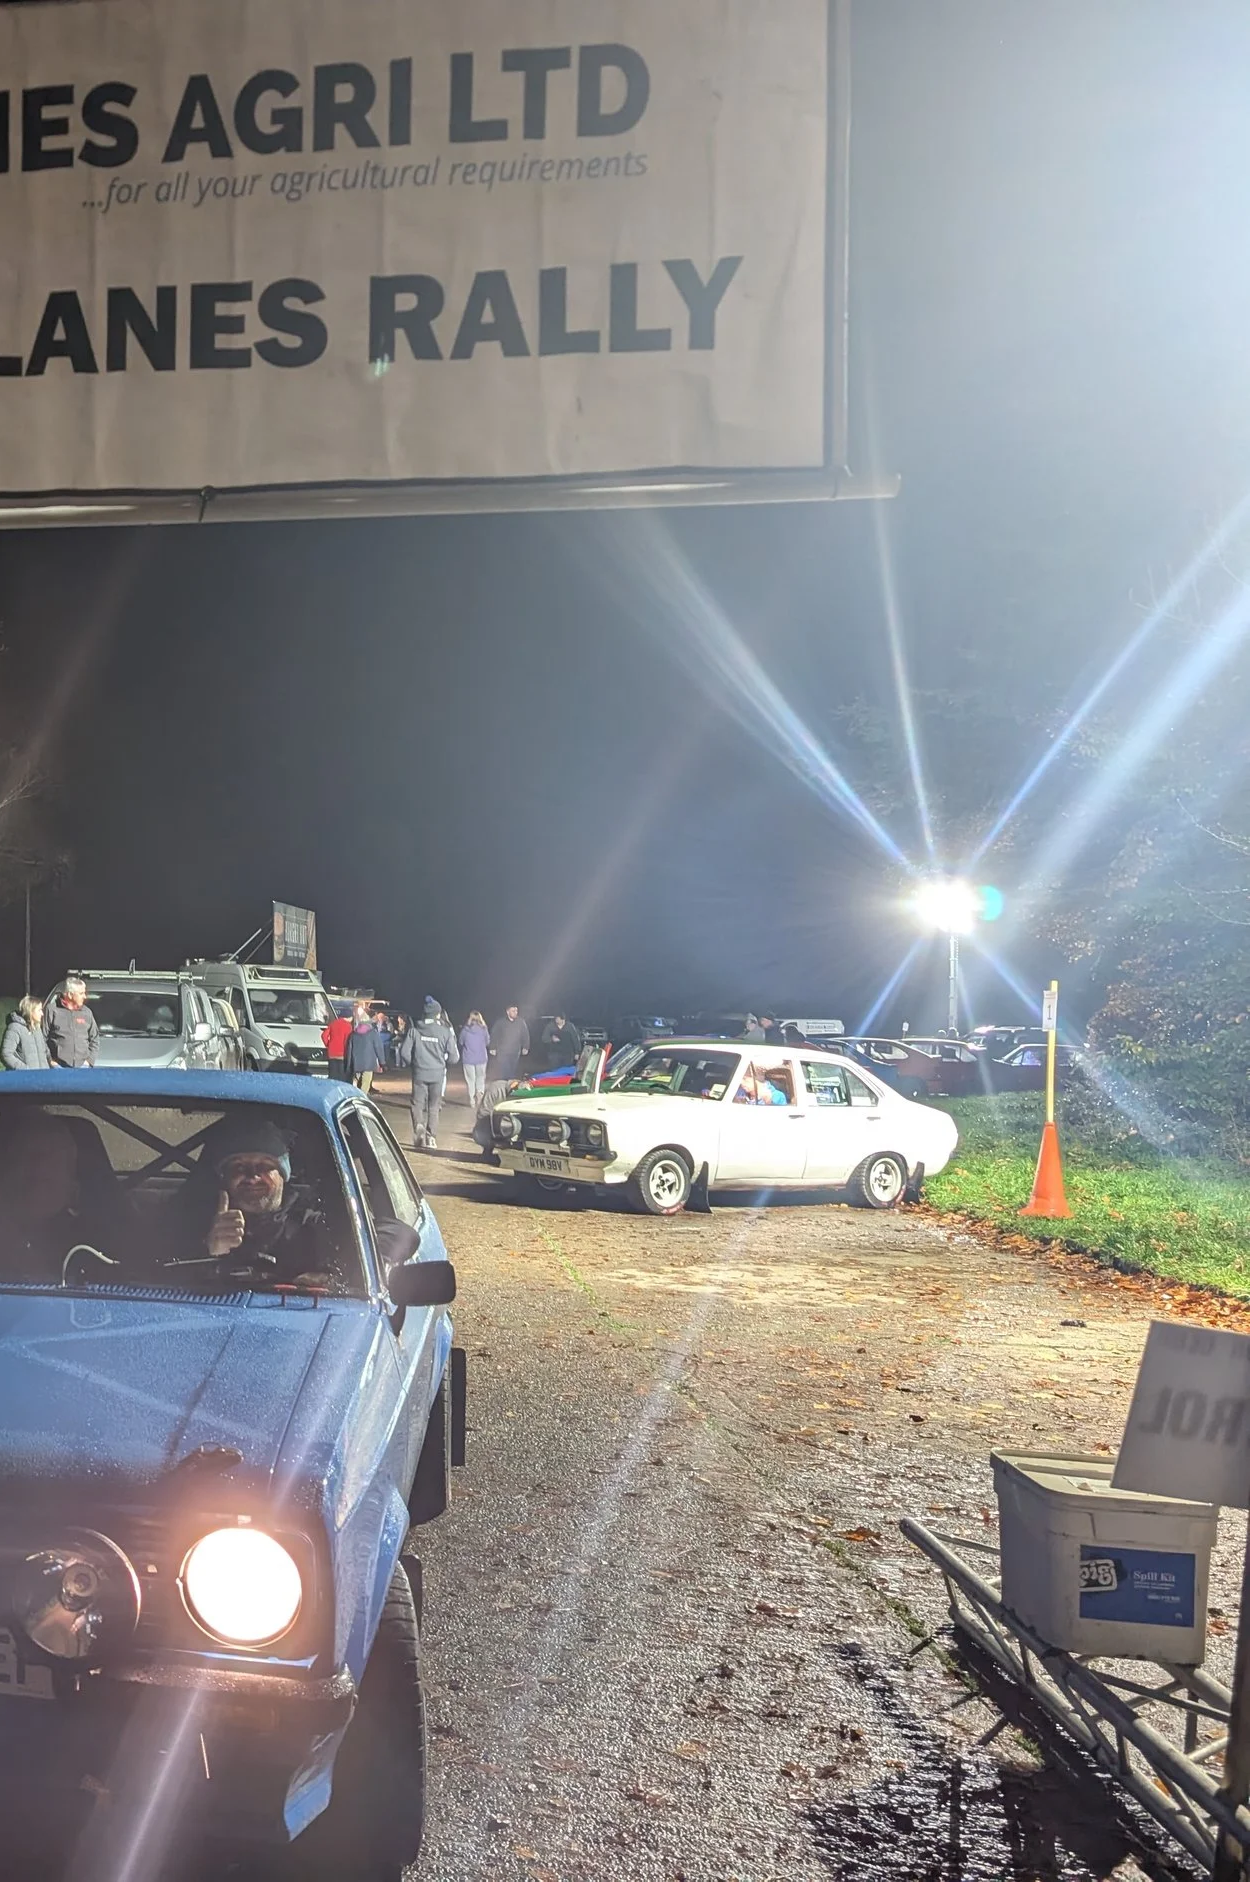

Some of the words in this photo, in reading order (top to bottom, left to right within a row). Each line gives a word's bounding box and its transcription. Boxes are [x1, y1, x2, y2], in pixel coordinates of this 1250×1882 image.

[161, 57, 413, 164] AGRI
[450, 42, 650, 144] LTD
[156, 171, 190, 203] all
[193, 173, 262, 208] your
[271, 156, 442, 201] agricultural
[449, 150, 649, 196] requirements
[368, 256, 744, 364] RALLY
[1133, 1570, 1158, 1582] Spill
[1160, 1572, 1176, 1583] Kit
